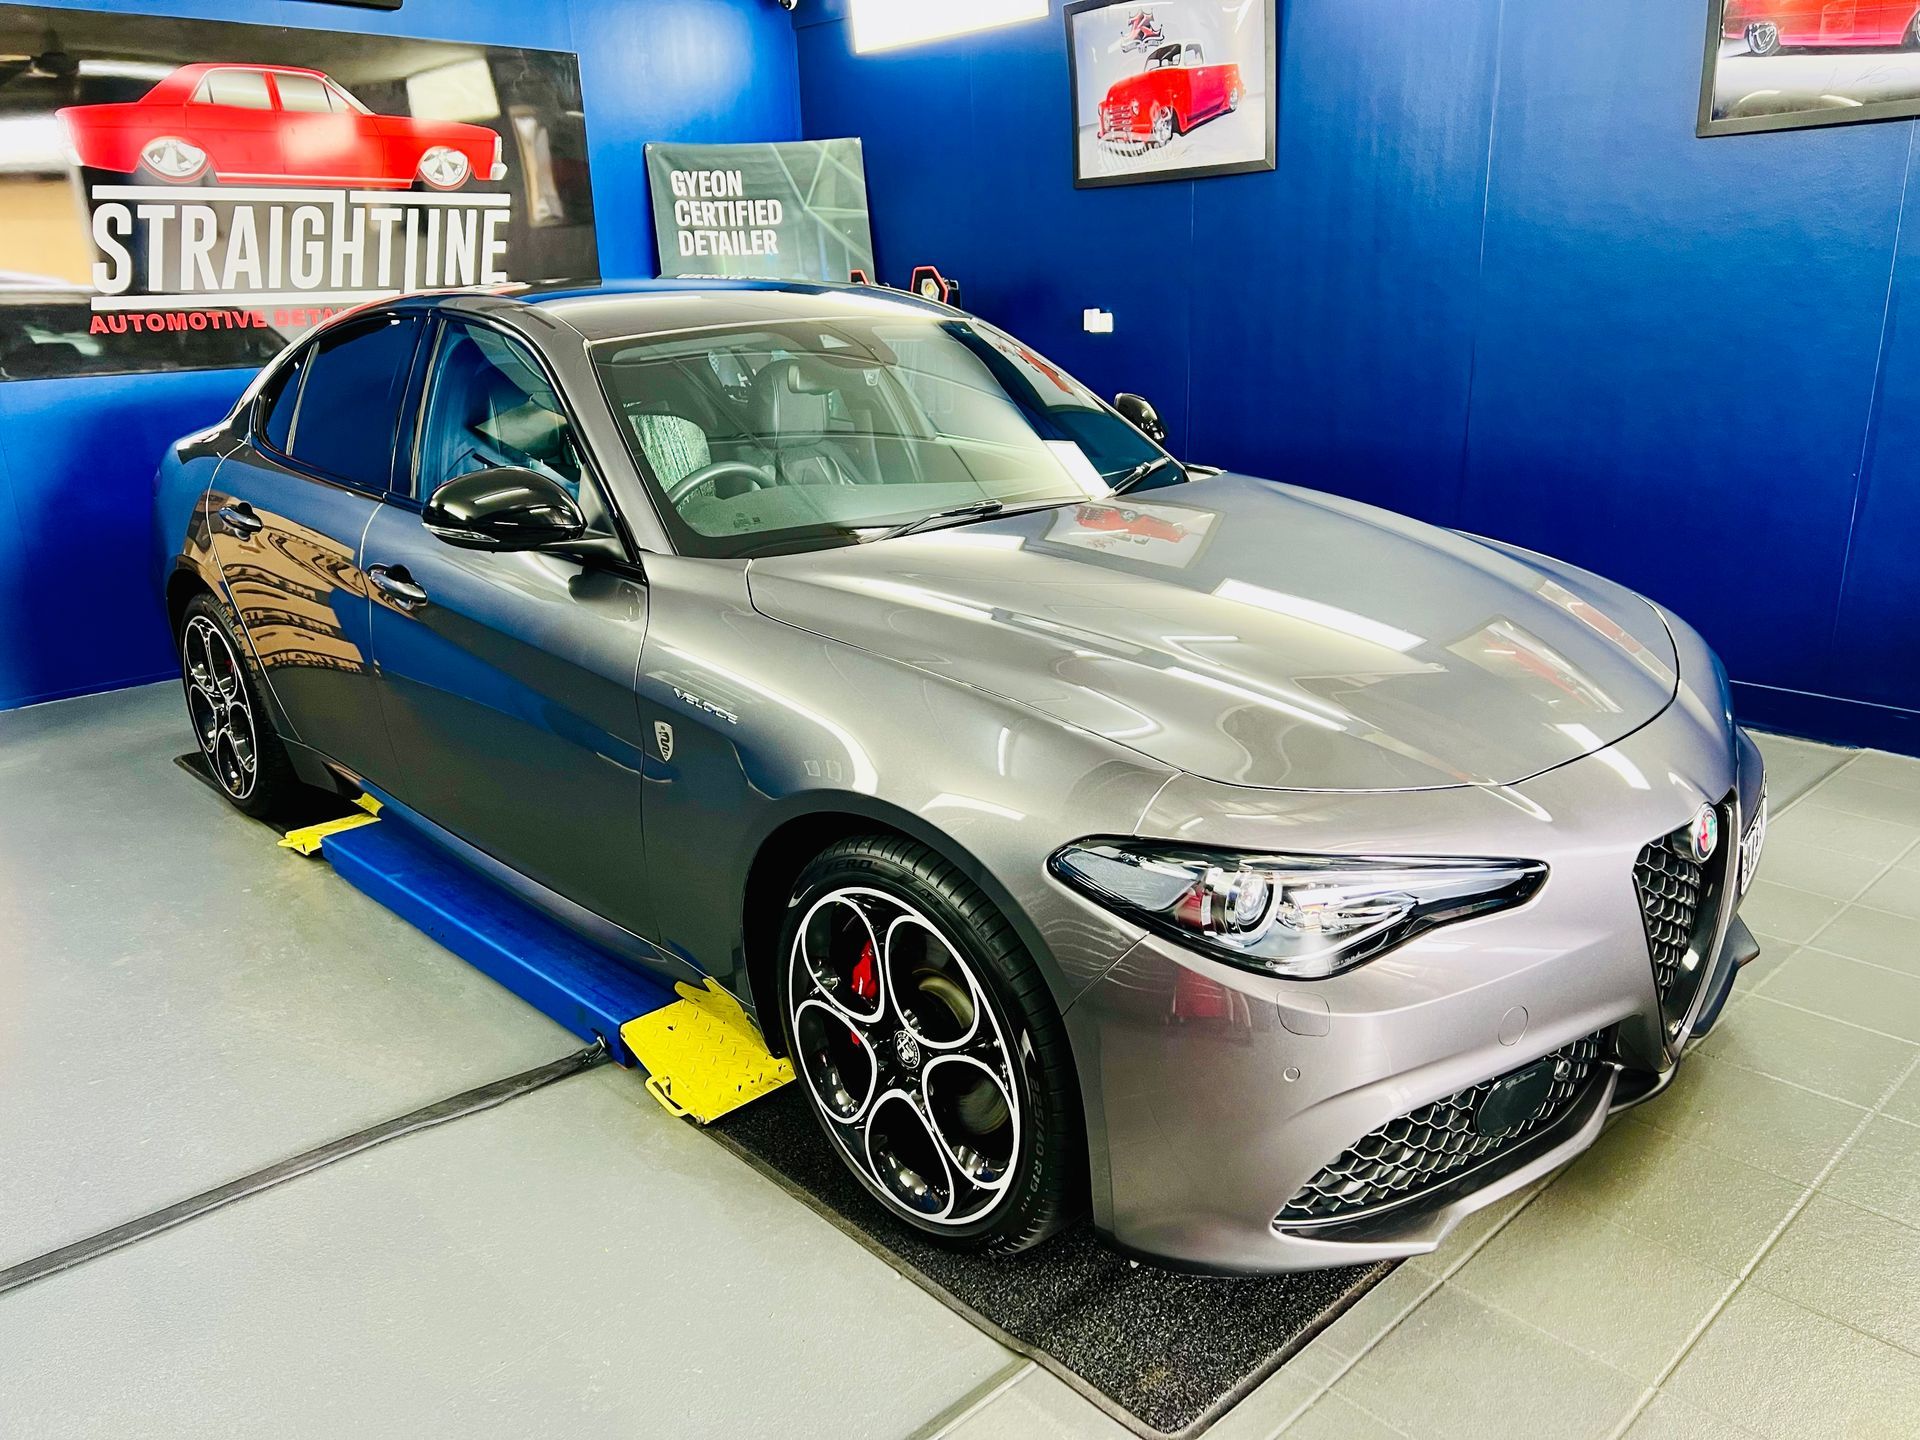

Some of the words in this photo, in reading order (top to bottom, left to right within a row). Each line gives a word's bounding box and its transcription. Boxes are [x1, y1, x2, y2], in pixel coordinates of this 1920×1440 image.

[671, 170, 743, 197] GYEON
[674, 199, 783, 226] CERTIFIED
[91, 202, 511, 295] STRAIGHTLINE
[678, 229, 779, 256] DETAILER
[90, 311, 268, 334] AUTOMOTIVE
[673, 687, 738, 724] VELOCE
